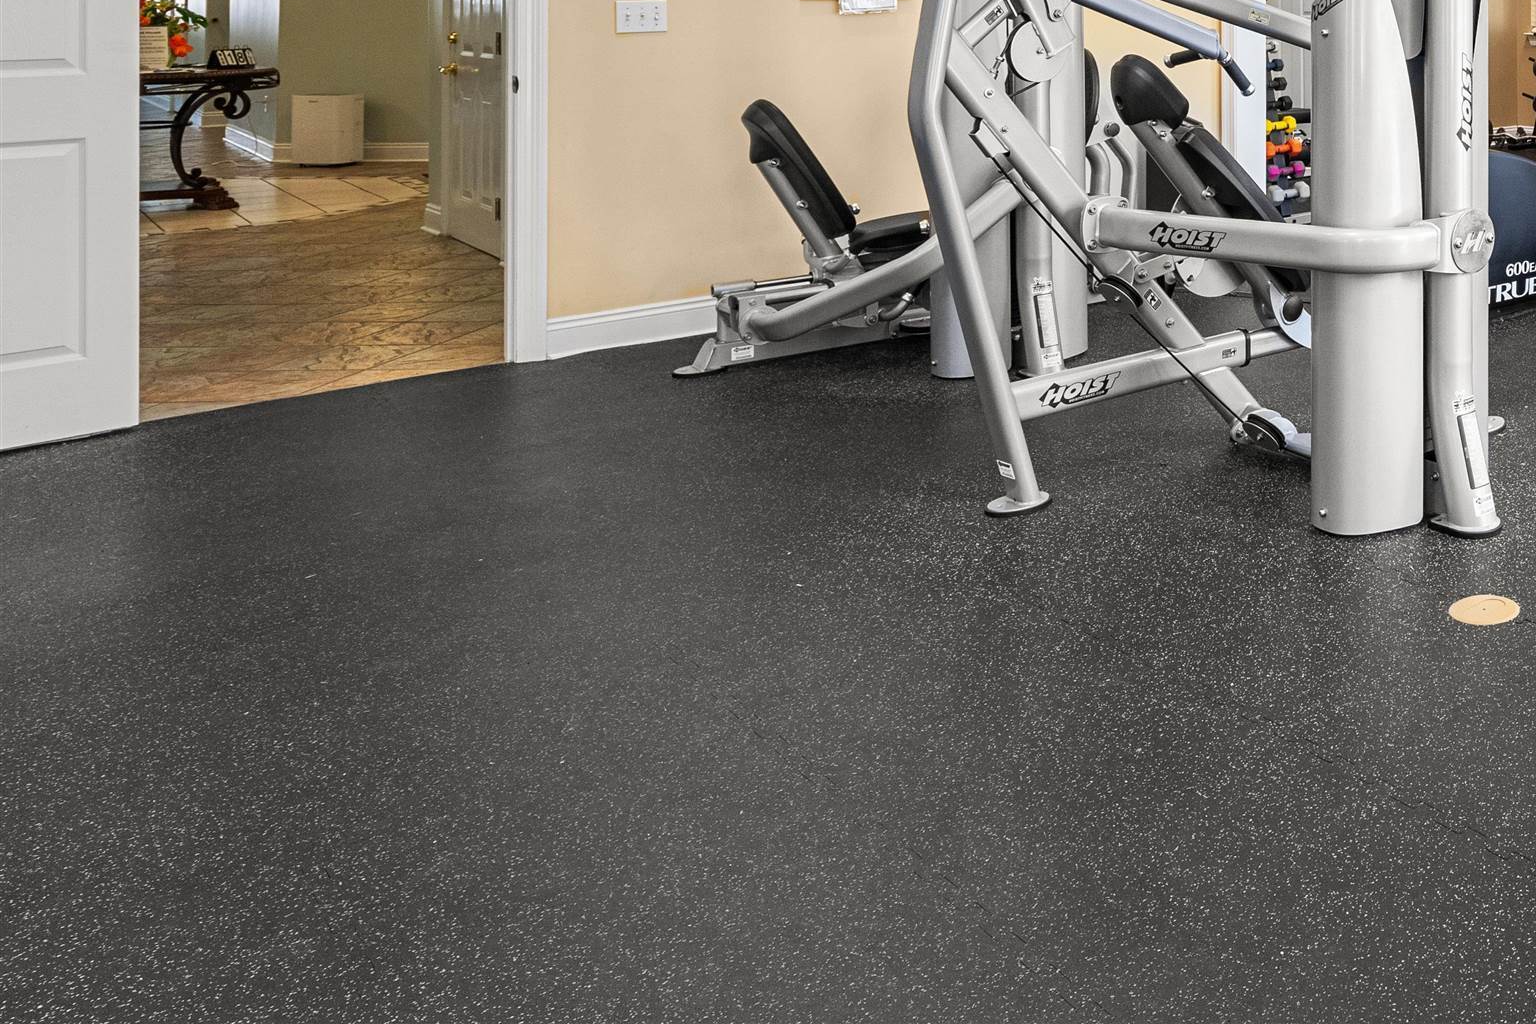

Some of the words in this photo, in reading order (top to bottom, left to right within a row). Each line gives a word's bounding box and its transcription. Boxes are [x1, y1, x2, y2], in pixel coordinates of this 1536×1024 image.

[1456, 51, 1473, 151] HOIST
[1150, 225, 1227, 249] HOIST
[1040, 370, 1122, 407] HOIST
